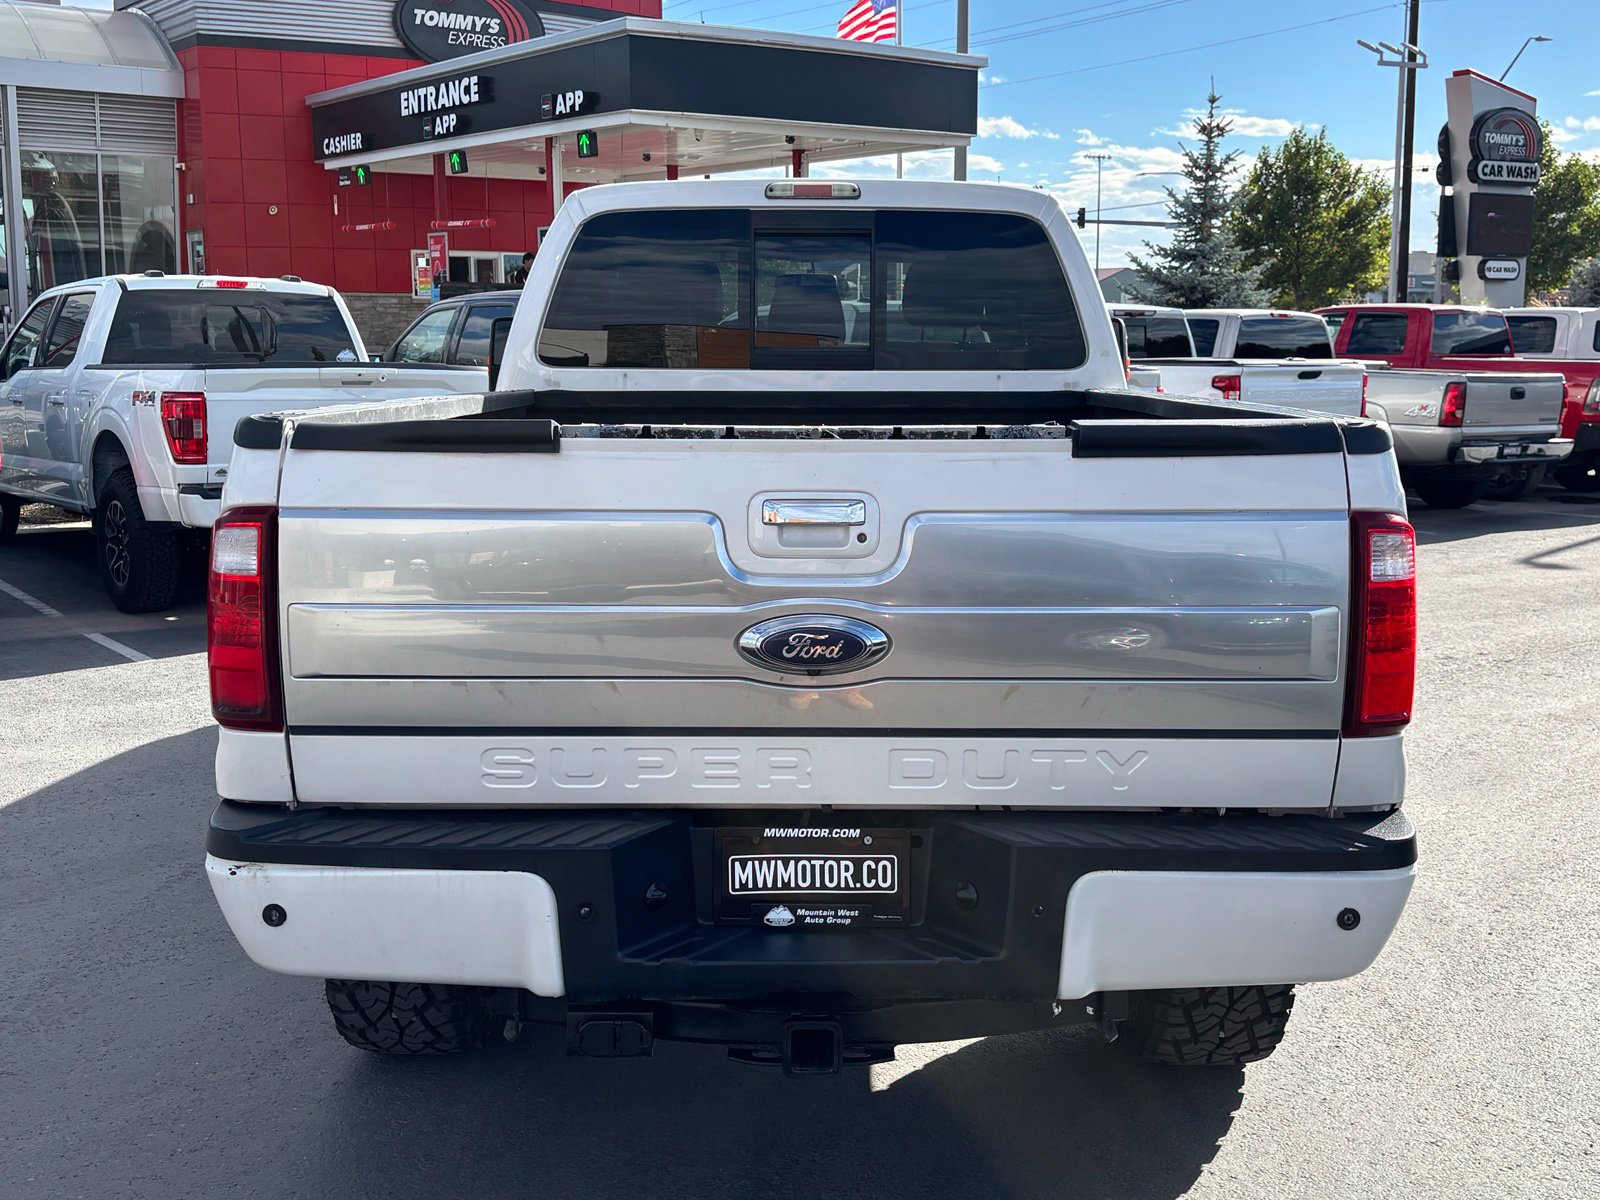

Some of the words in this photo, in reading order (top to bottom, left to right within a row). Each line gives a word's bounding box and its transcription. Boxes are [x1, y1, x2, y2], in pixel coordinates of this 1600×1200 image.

[414, 8, 501, 34] TOMMY'S
[448, 31, 506, 49] EXPRESS
[400, 75, 479, 117] ENTRANCE
[555, 90, 584, 115] APP
[434, 114, 457, 135] APP
[323, 132, 363, 155] CASHIER
[1484, 132, 1525, 146] TOMMY'S
[1498, 146, 1526, 156] EXPRESS
[1481, 163, 1504, 178] CAR
[1506, 165, 1537, 180] WASH
[132, 391, 155, 406] FX4
[782, 632, 844, 659] Ford
[479, 746, 813, 790] SUPER
[887, 747, 1150, 791] DUTY
[763, 828, 860, 838] MWMOTOR.COM
[734, 859, 893, 889] MWMOTOR.CO
[796, 908, 835, 917] Mountain
[837, 908, 860, 917] West
[804, 916, 825, 924] Auto
[826, 916, 852, 926] Group
